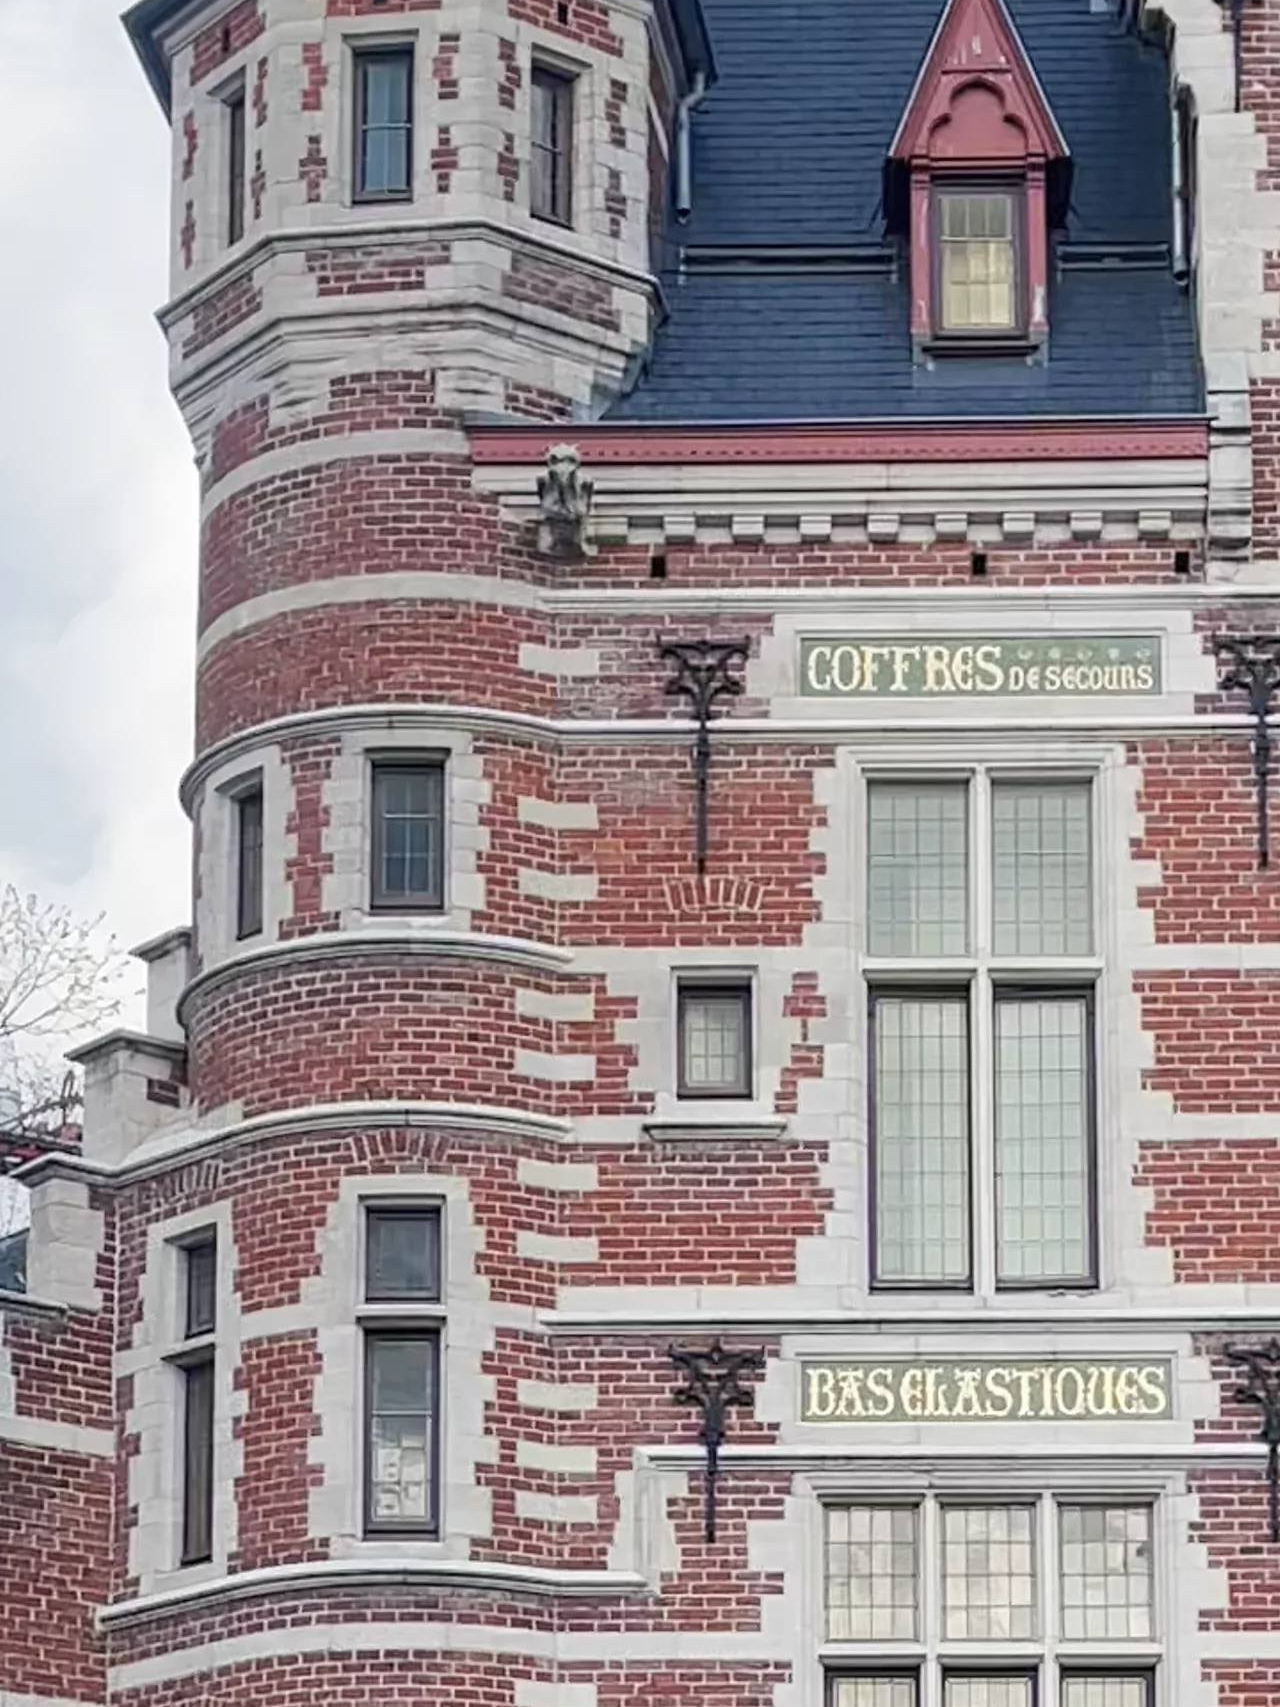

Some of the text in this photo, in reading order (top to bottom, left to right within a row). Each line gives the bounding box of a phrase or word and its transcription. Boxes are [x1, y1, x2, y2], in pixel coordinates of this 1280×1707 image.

[807, 644, 1154, 692] COFFRES DE SECOURS
[804, 1365, 1168, 1418] BAS ELASTIQUES
